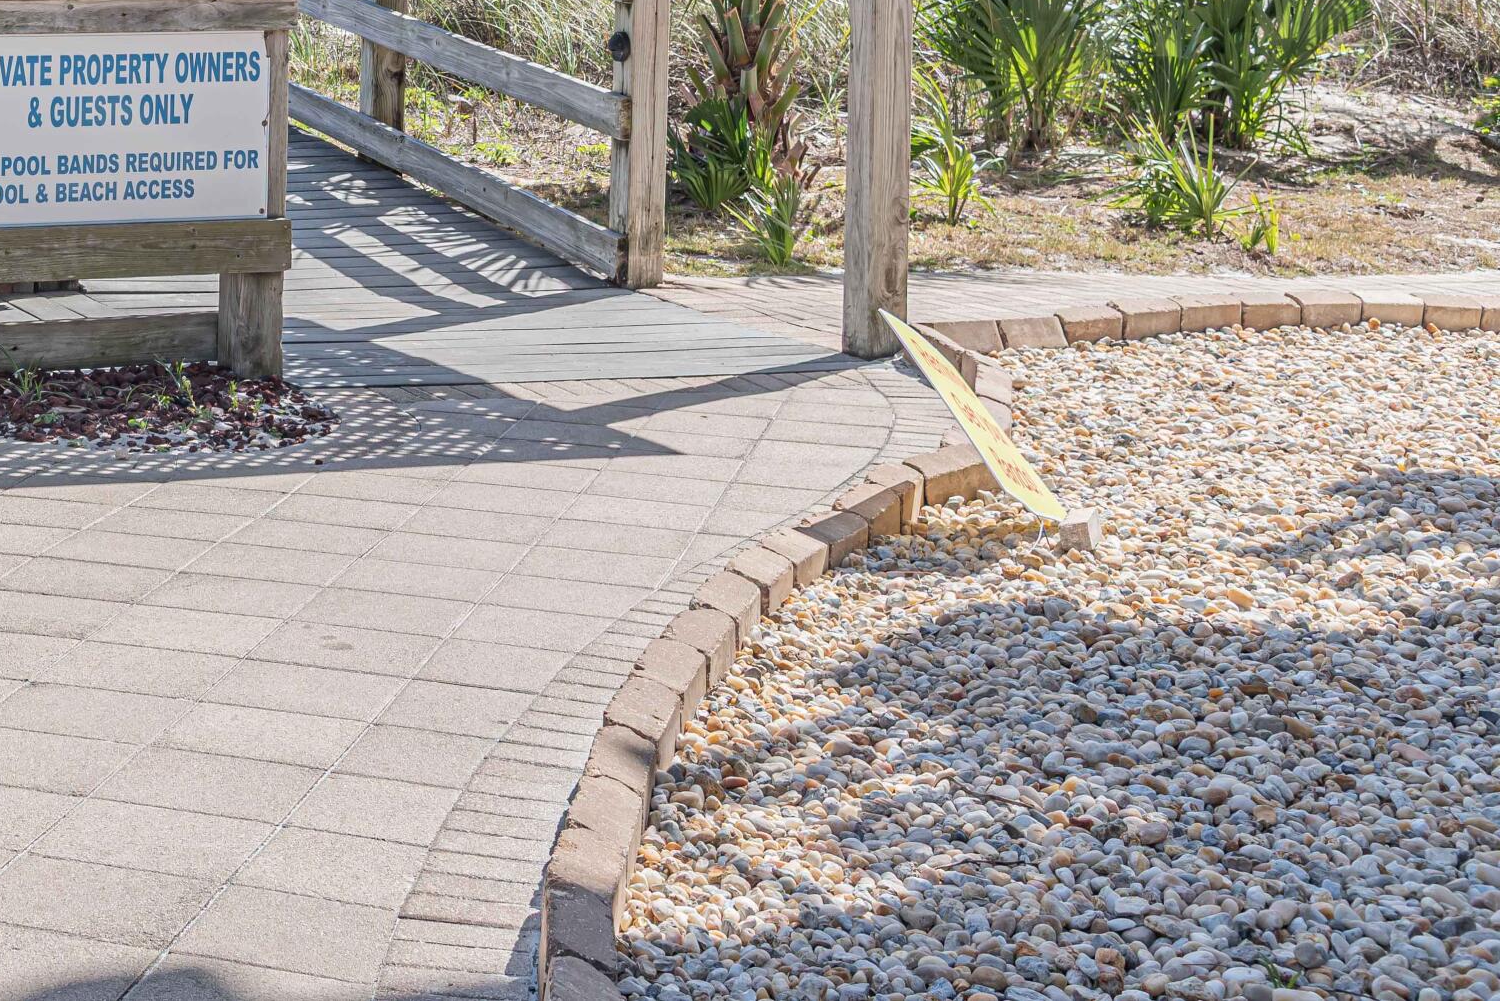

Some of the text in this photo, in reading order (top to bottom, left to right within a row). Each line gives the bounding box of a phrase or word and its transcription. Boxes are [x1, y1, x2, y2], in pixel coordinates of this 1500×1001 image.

[59, 53, 169, 86] PROPERTY
[175, 51, 261, 84] OWNERS
[27, 93, 194, 128] & GUESTS ONLY
[1, 155, 51, 176] POOL
[57, 153, 119, 175] BANDS
[125, 150, 218, 173] REQUIRED
[223, 150, 259, 170] FOR
[35, 183, 48, 203] &
[55, 181, 117, 203] BEACH
[123, 178, 195, 200] ACCESS
